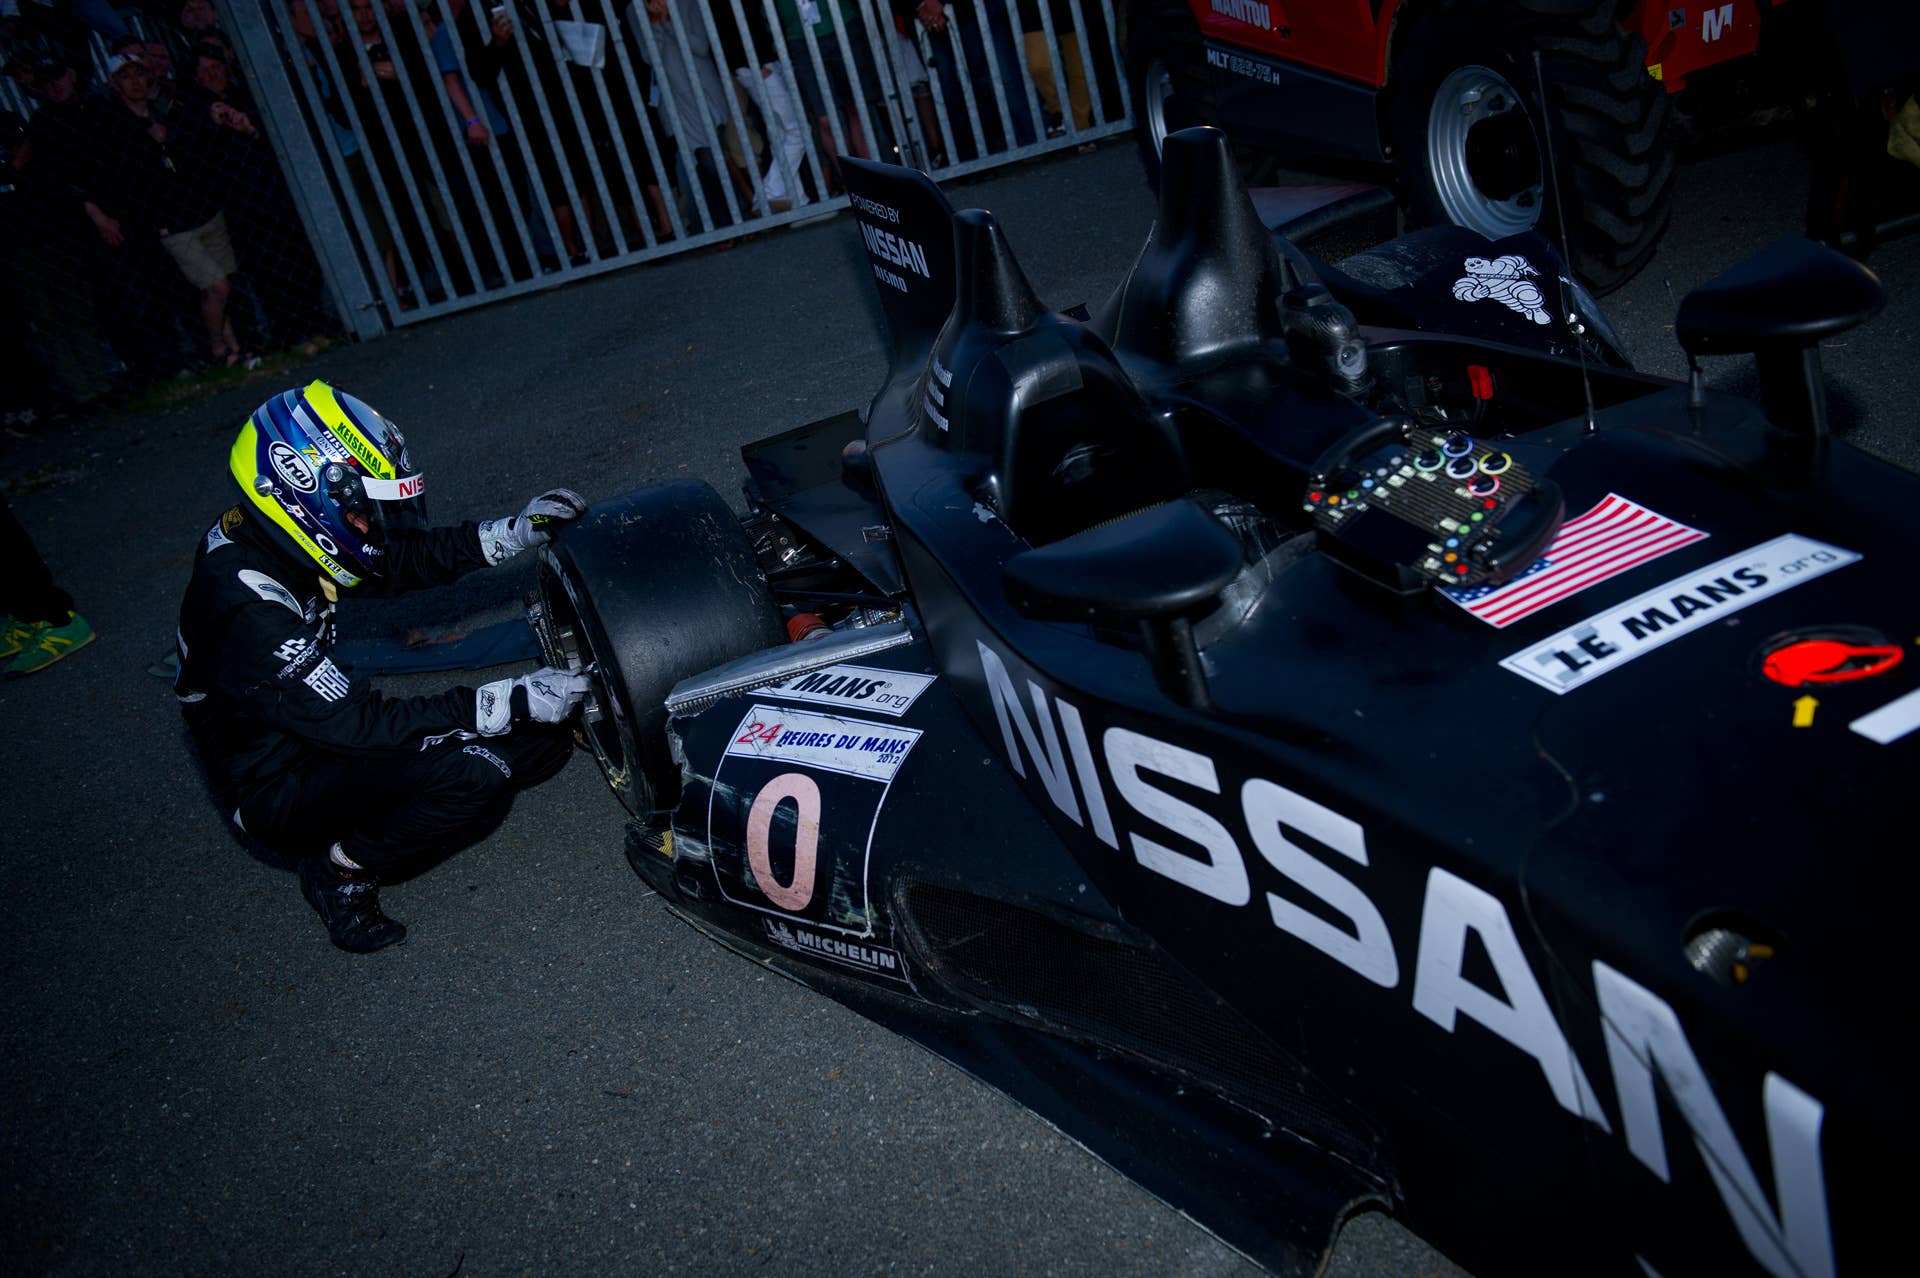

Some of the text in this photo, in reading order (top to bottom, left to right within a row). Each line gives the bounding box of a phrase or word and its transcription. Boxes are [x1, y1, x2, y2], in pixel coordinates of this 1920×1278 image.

[1206, 48, 1230, 70] MLT
[1272, 71, 1280, 86] H
[851, 192, 900, 224] POWERED BY
[860, 220, 930, 279] NISSAN
[272, 446, 314, 487] Arai
[336, 422, 381, 473] KEISEIKAI
[1554, 635, 1616, 672] LE
[1622, 567, 1768, 640] MANS
[791, 673, 886, 699] MANS
[736, 723, 911, 754] 24 HEURES DU MANS
[876, 754, 901, 765] 2012
[746, 772, 822, 912] 0
[797, 929, 896, 970] MICHELIN
[975, 638, 1840, 1278] NISSAN
